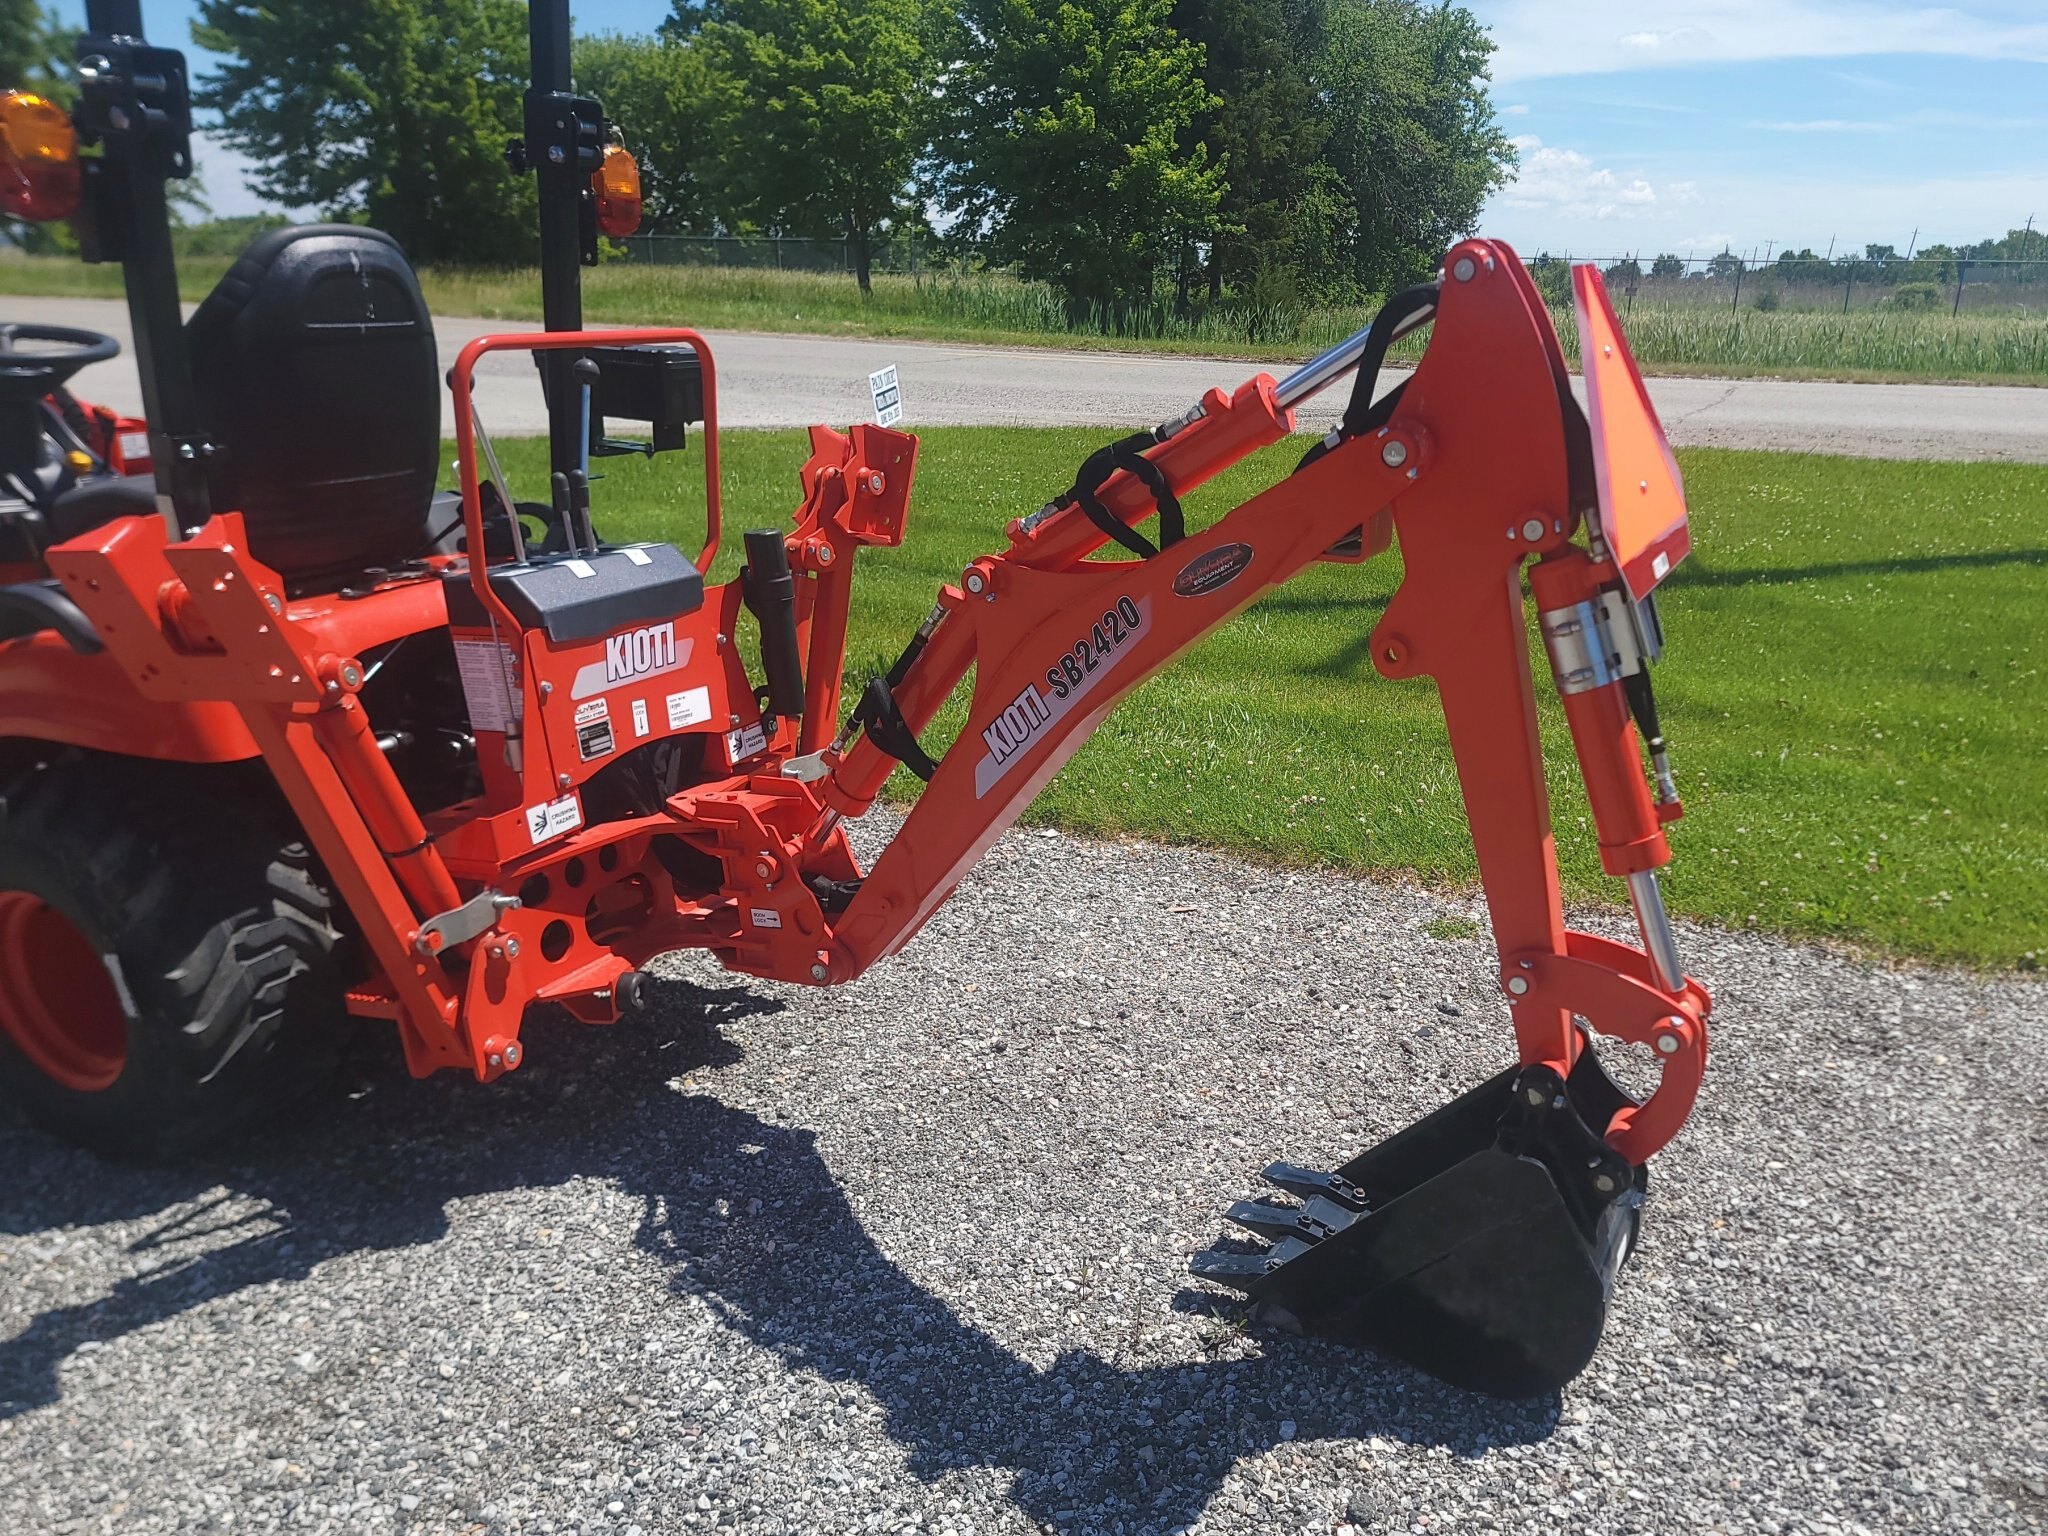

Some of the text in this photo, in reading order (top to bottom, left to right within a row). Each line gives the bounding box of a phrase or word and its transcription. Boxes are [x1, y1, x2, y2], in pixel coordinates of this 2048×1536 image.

[1193, 561, 1234, 586] EQUIPMENT
[606, 620, 676, 683] KIOTI
[981, 595, 1142, 765] KIOTI SB2420
[748, 738, 764, 748] HAZARD
[551, 806, 577, 820] CRUSHING
[556, 814, 575, 825] HAZARD
